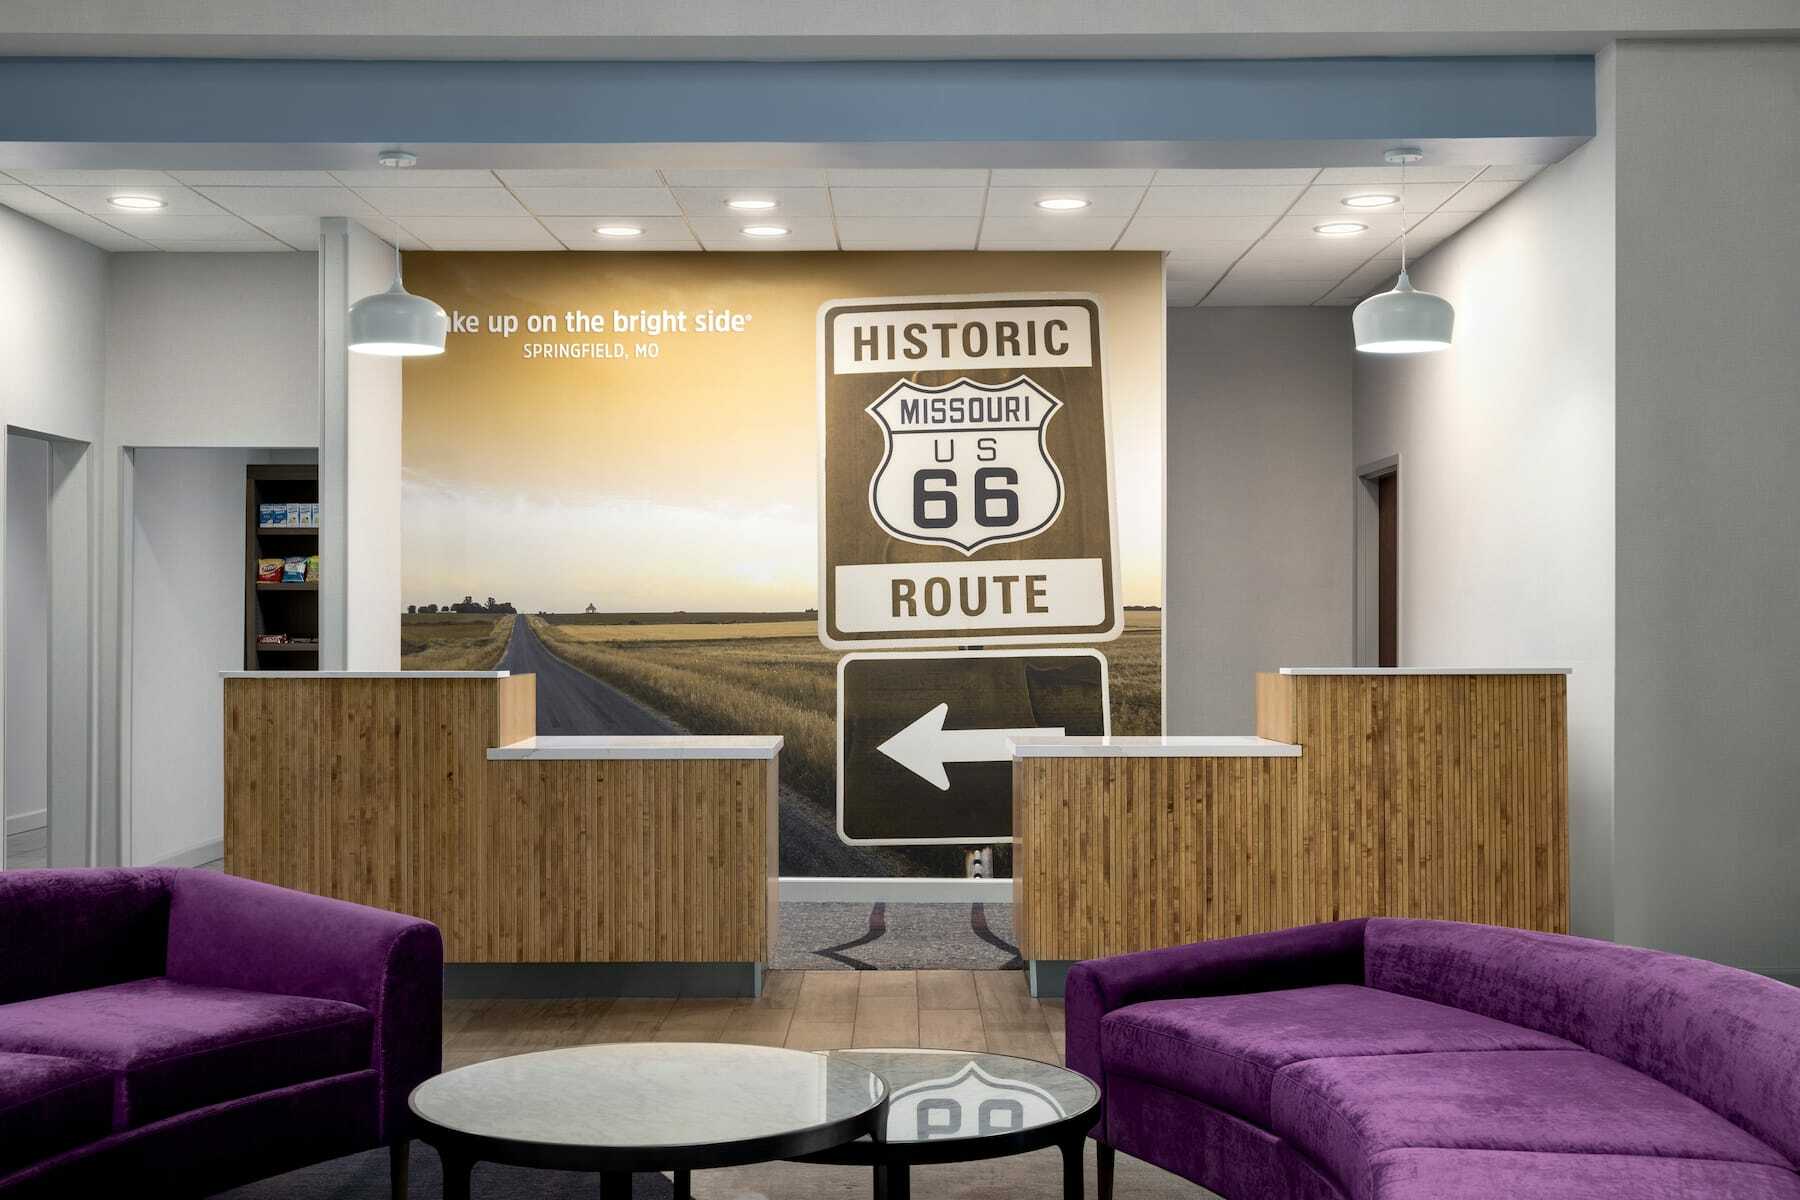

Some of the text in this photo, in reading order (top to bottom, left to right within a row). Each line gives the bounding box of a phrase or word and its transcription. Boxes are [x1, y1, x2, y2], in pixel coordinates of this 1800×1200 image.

[488, 314, 519, 338] up
[527, 313, 557, 333] on
[565, 311, 604, 333] the
[613, 309, 687, 337] bright
[853, 319, 1070, 362] HISTORIC
[523, 342, 660, 360] SPRINGFIELD, MO
[900, 396, 1031, 426] MISSOURI
[912, 466, 1020, 529] 66
[891, 574, 1049, 618] ROUTE
